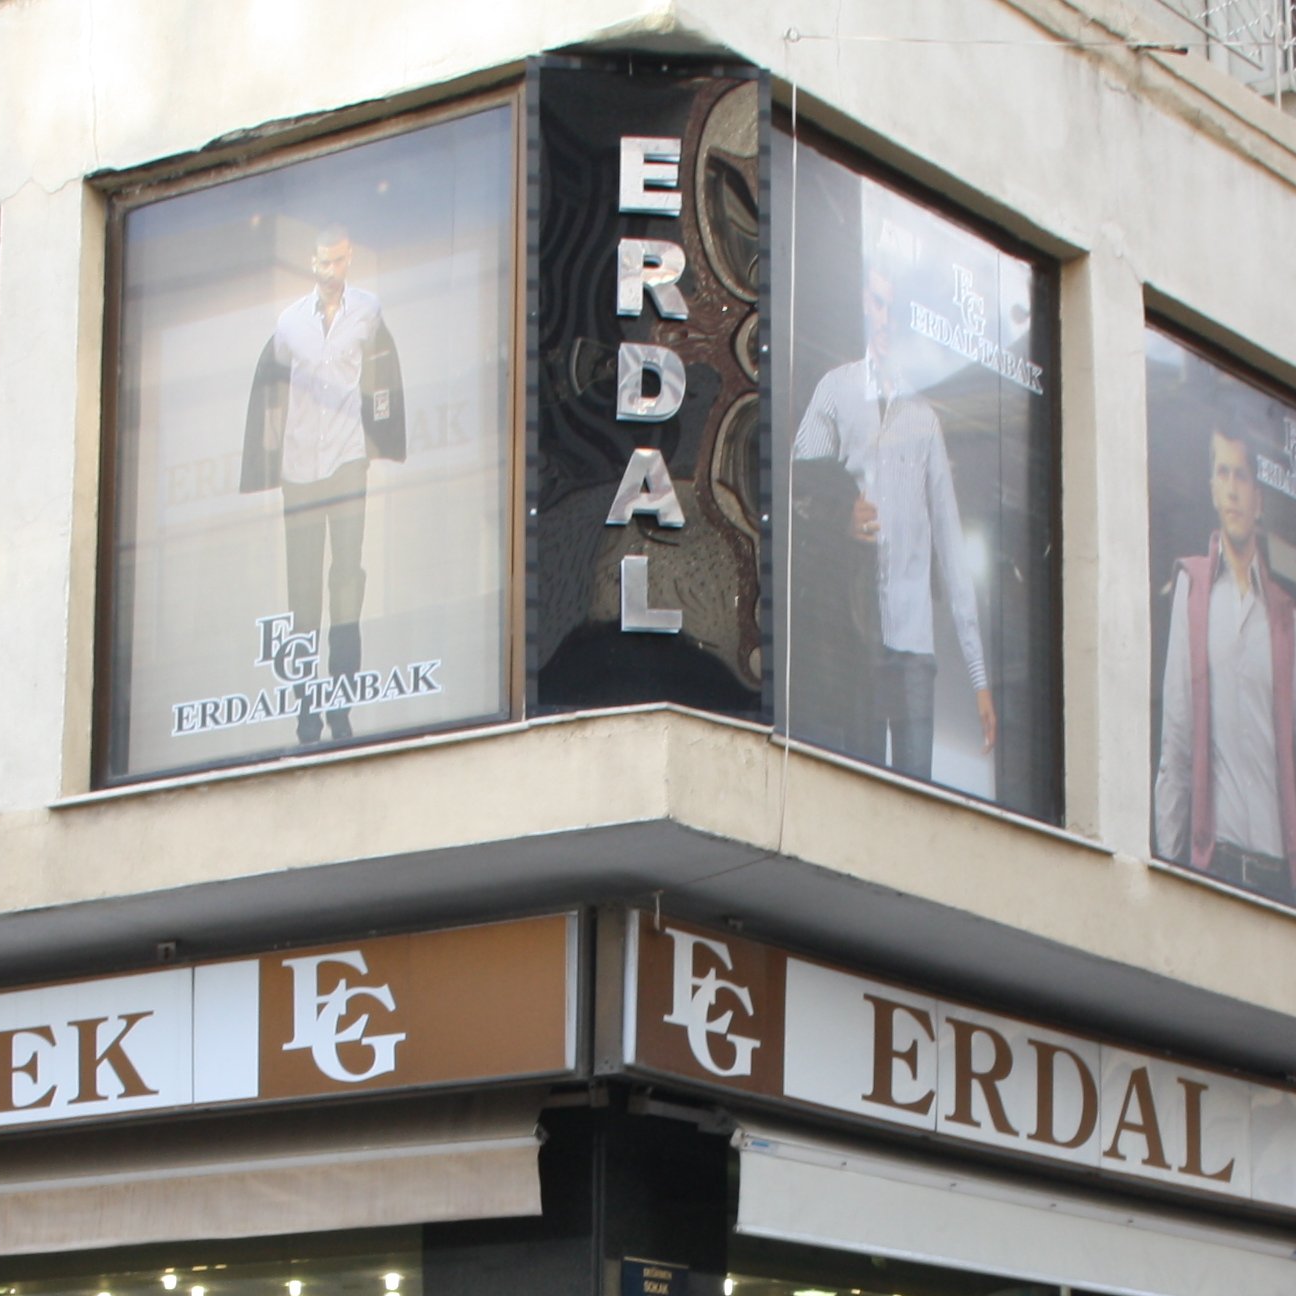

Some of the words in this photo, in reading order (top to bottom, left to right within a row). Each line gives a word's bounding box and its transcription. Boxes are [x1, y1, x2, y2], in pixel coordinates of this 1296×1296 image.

[605, 137, 688, 633] ERDAL
[910, 301, 978, 363] ERDAL
[978, 336, 1043, 395] TABAK
[171, 683, 302, 736] ERDAL
[304, 660, 442, 713] TABAK
[862, 992, 1235, 1183] ERDAL
